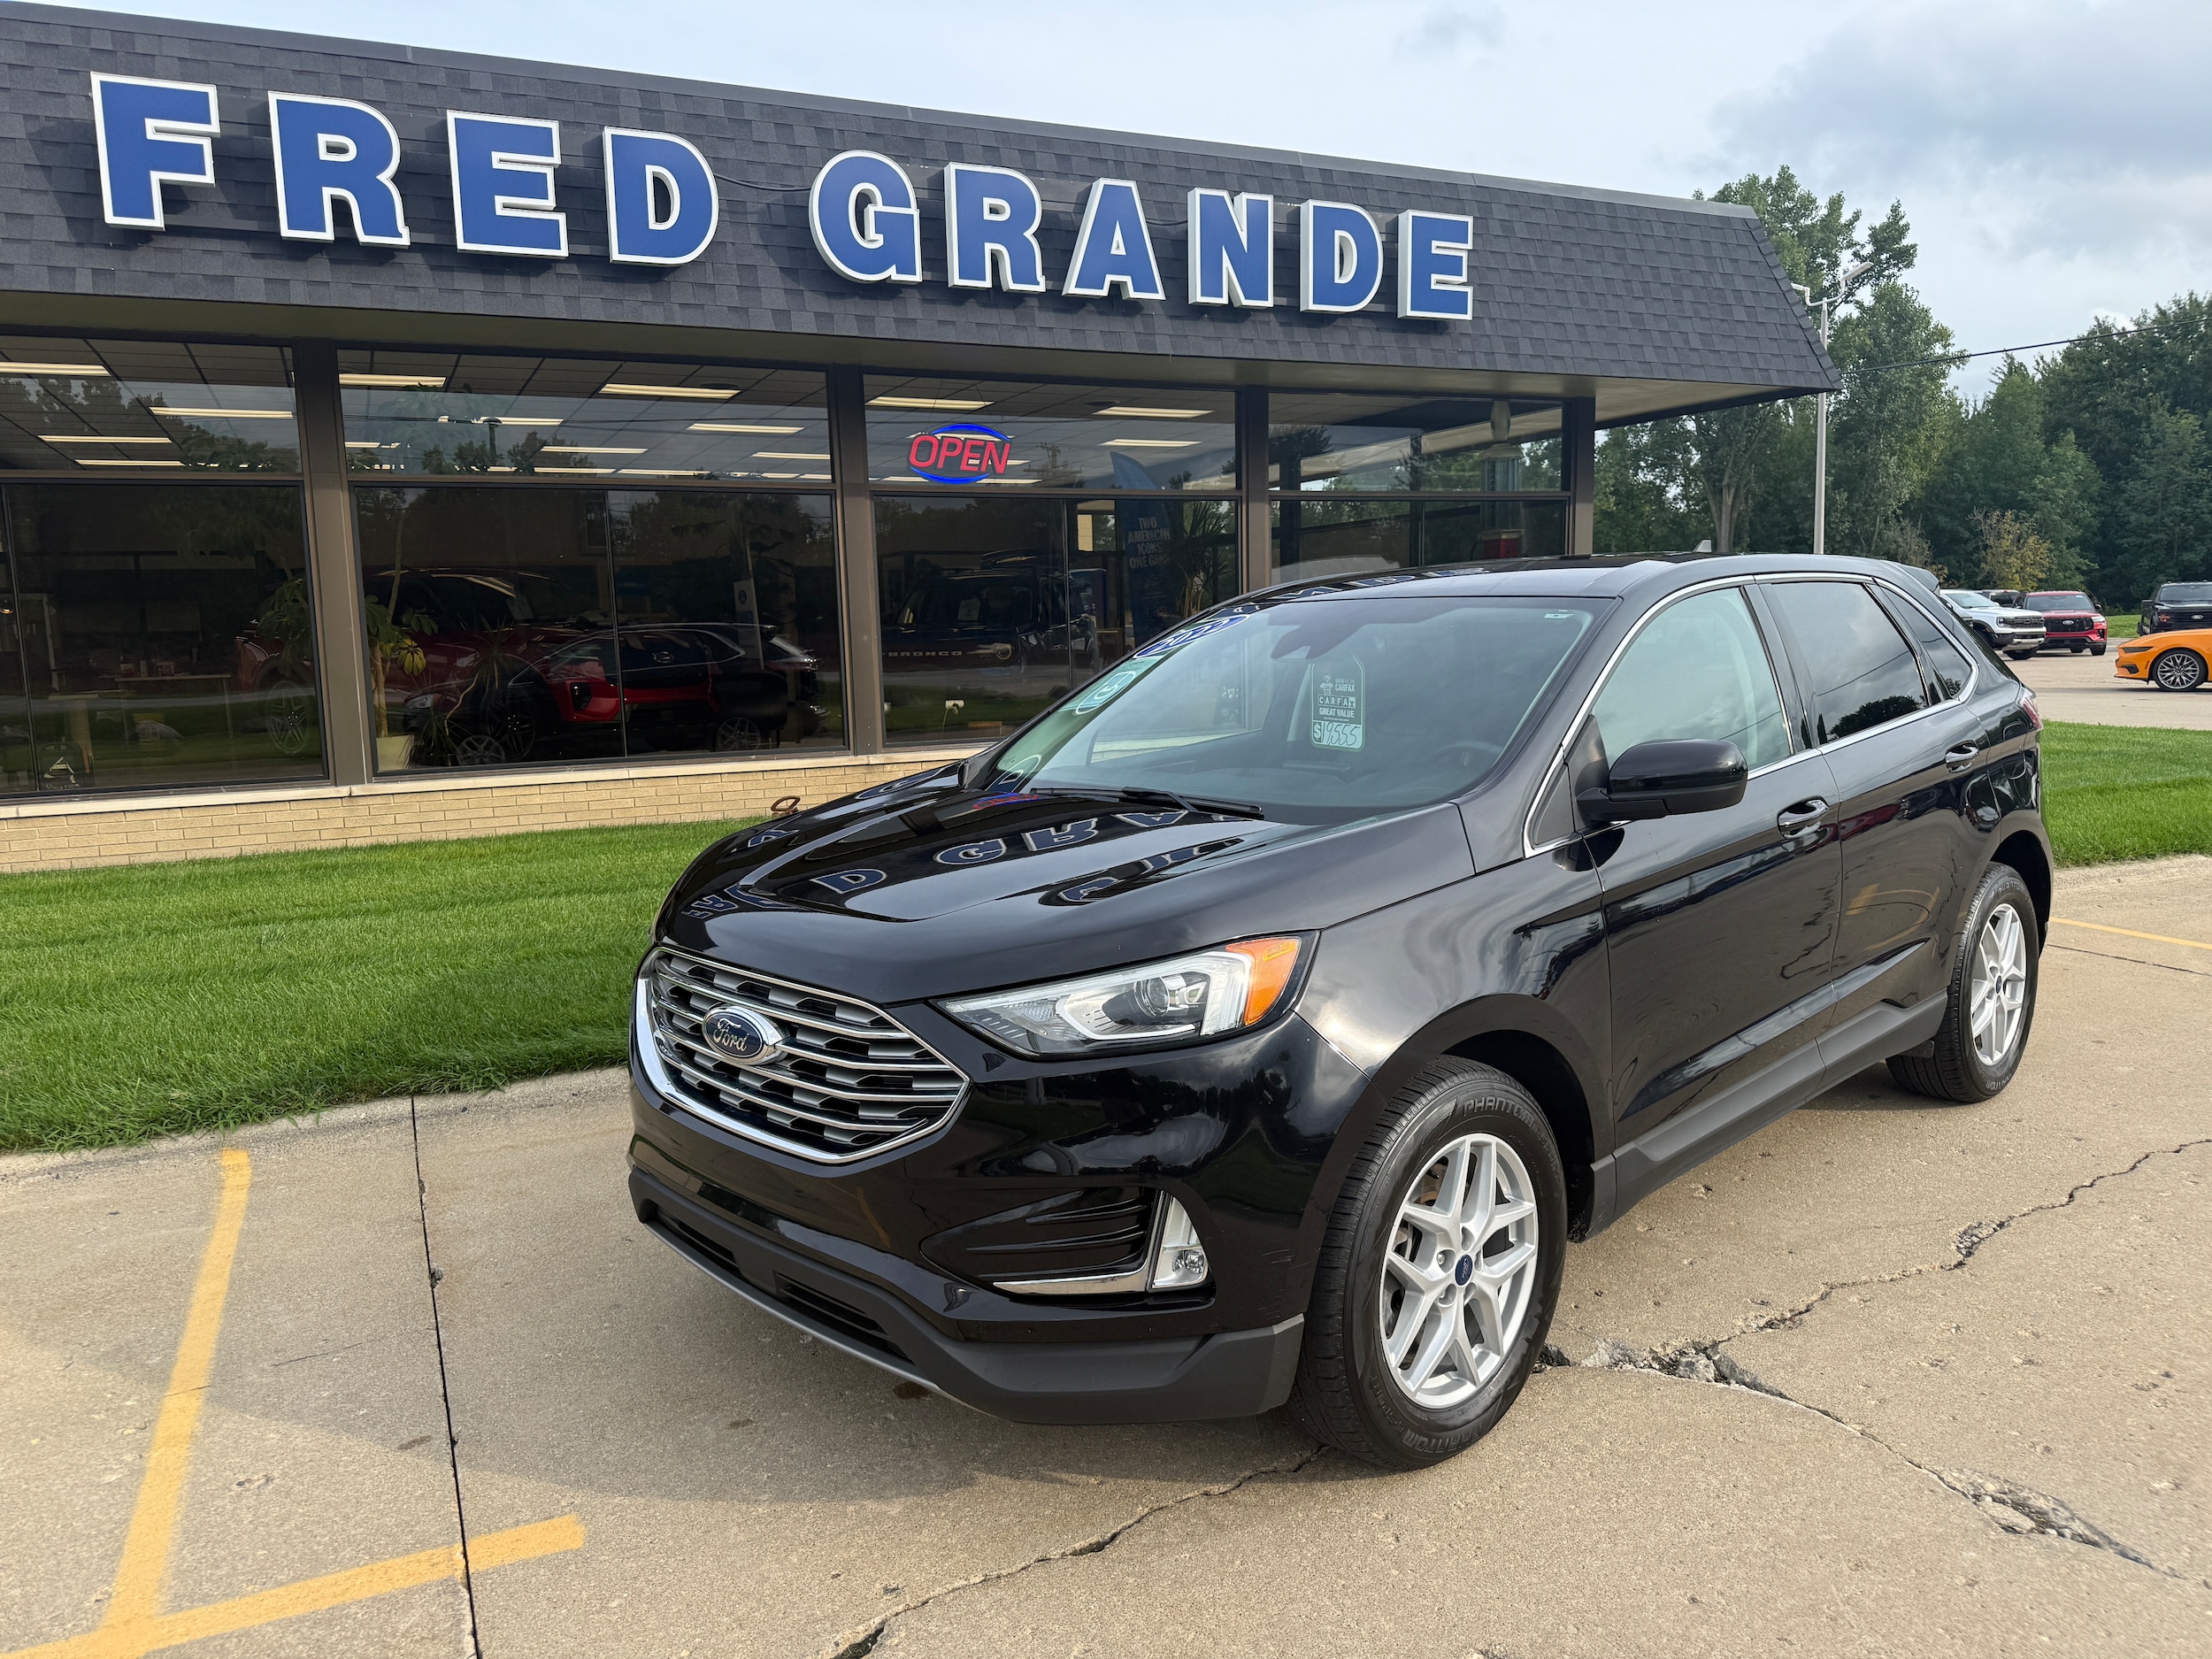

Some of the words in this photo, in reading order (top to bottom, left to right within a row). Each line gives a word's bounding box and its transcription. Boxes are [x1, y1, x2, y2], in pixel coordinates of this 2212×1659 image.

[90, 72, 719, 267] FRED
[809, 149, 1475, 320] GRANDE
[910, 435, 1011, 473] OPEN
[1138, 517, 1157, 530] TWO
[1128, 528, 1171, 543] AMERICAN
[1137, 541, 1164, 556] ICONS
[1129, 556, 1148, 569] ONE
[1335, 683, 1356, 692] CARFAX
[1318, 695, 1356, 708] CARFAX
[1319, 707, 1336, 716] GREAT
[1336, 709, 1355, 718] VALUE
[713, 1018, 749, 1051] Ford
[1463, 1095, 1534, 1127] PHANTOM
